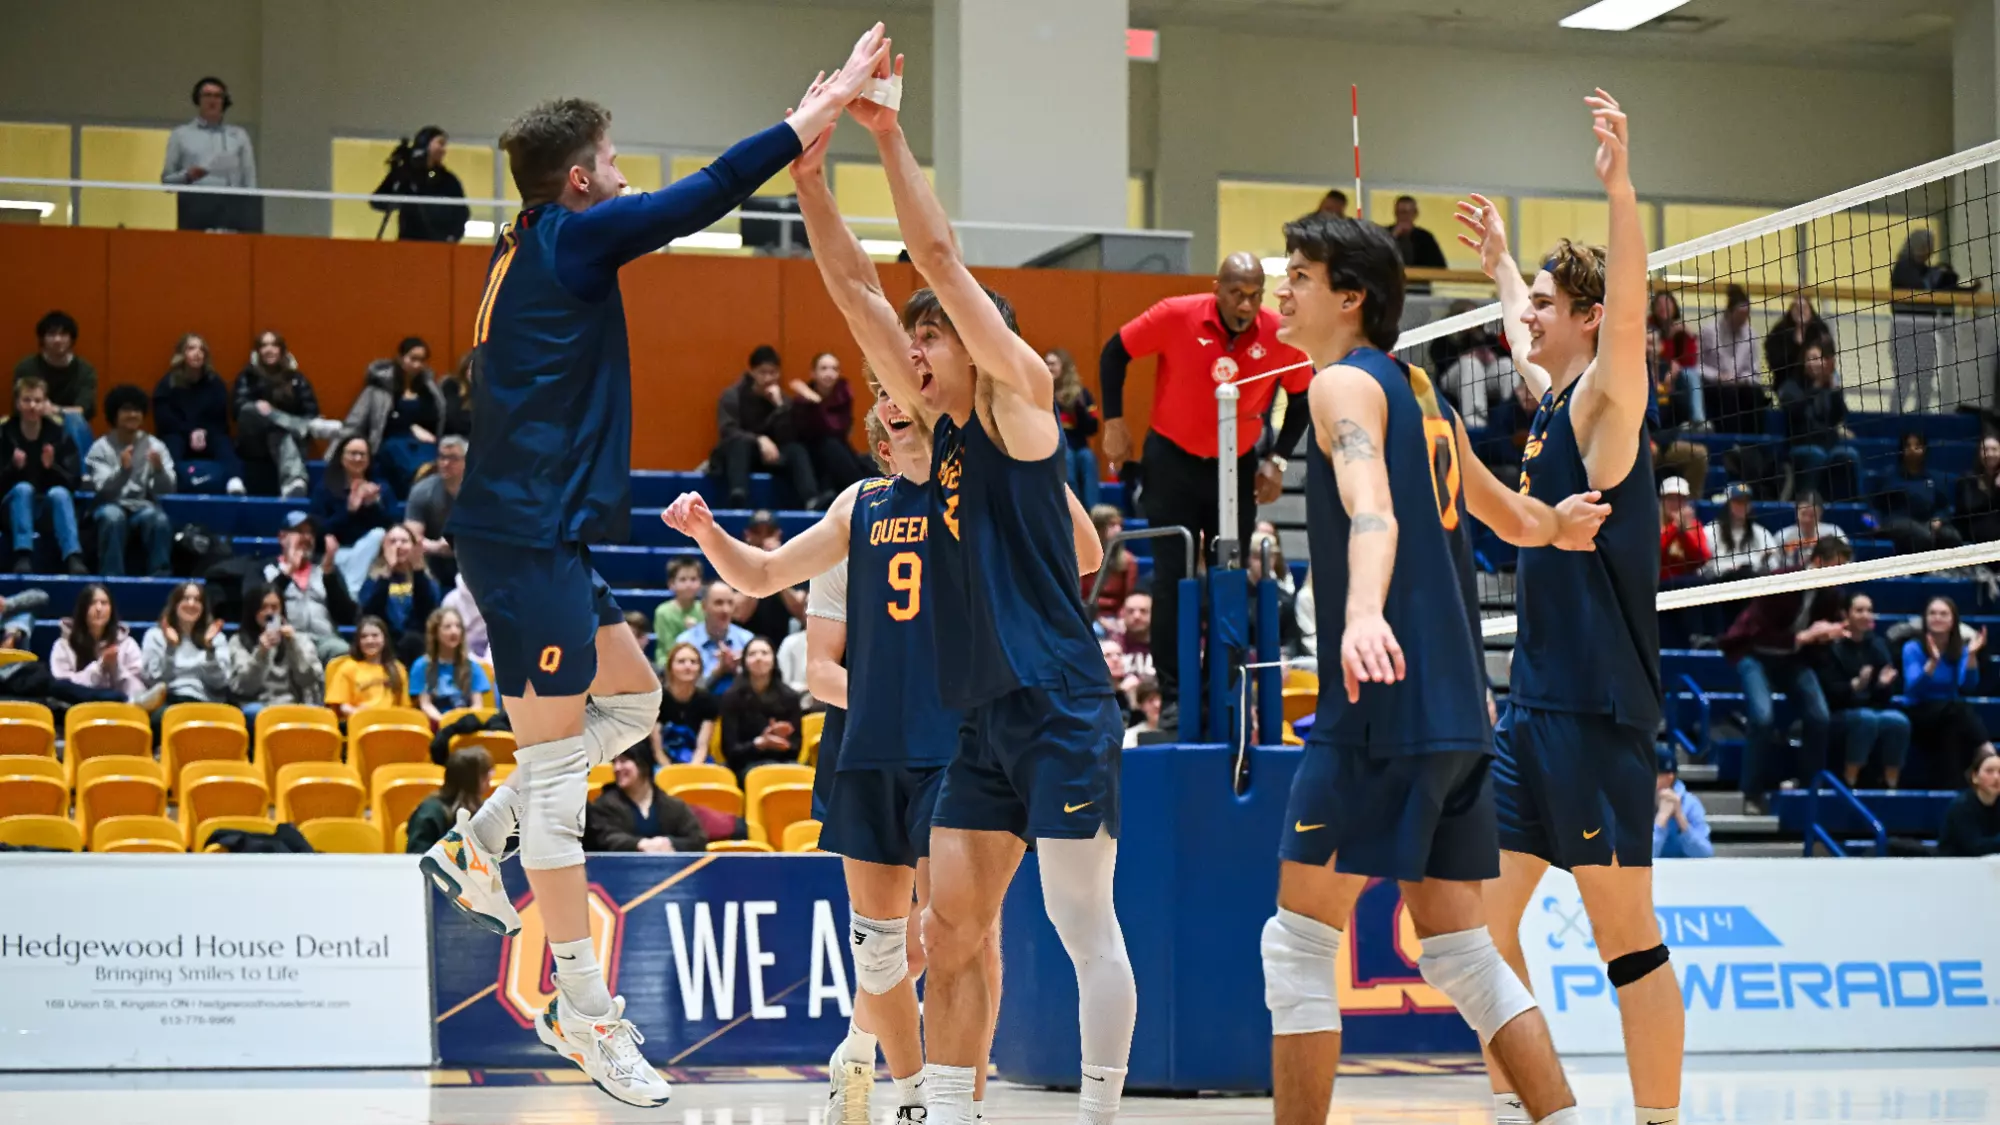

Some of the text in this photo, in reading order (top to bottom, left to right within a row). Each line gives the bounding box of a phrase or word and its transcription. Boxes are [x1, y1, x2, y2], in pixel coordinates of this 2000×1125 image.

[887, 551, 923, 621] 9
[3, 933, 389, 966] Hedgewood House Dental
[664, 901, 787, 1022] WE
[95, 965, 299, 985] Bringing Smiles to Life
[1551, 960, 1988, 1012] PWERADE
[121, 999, 167, 1011] Kingston
